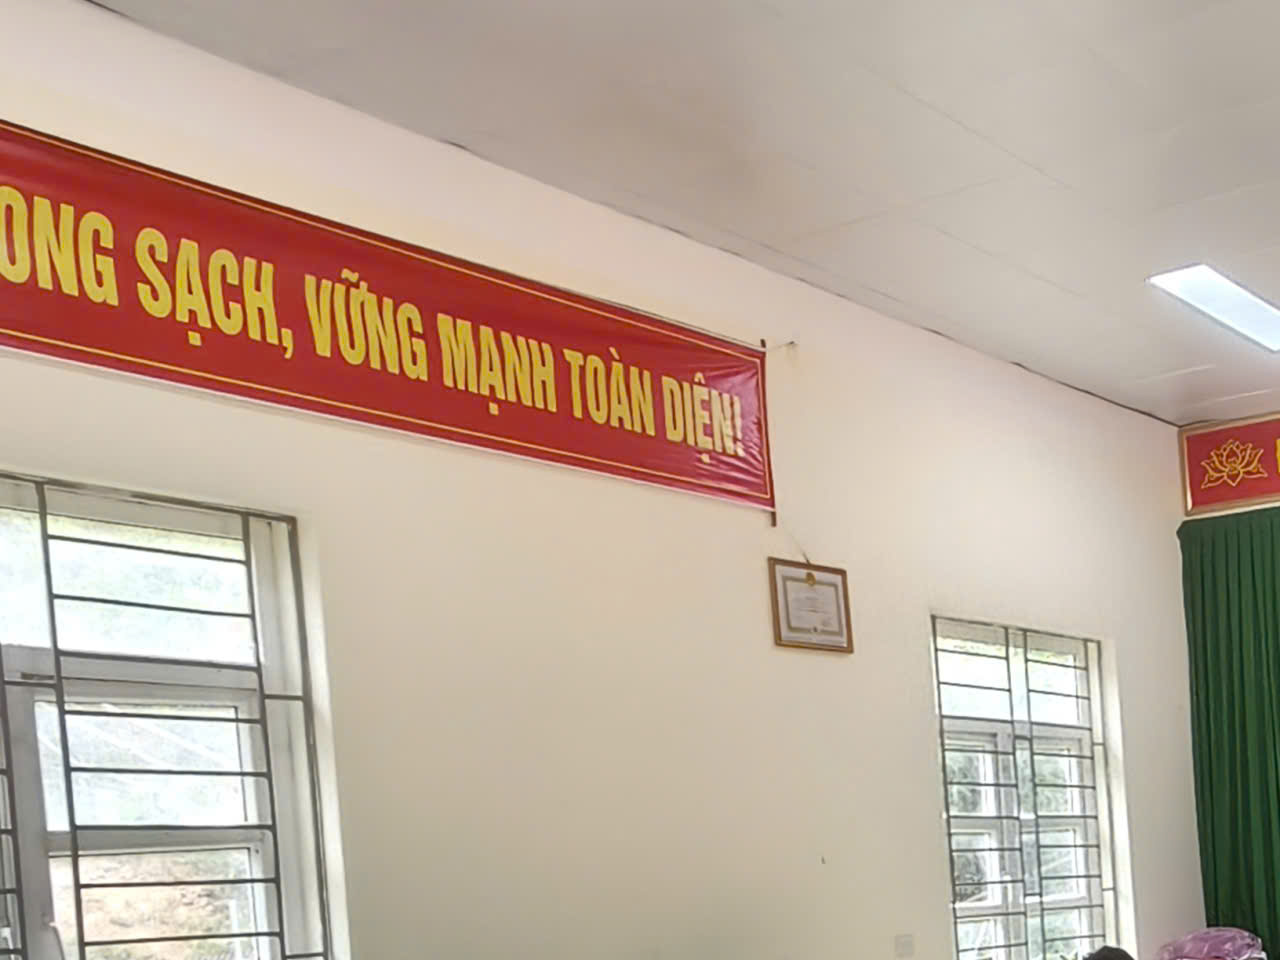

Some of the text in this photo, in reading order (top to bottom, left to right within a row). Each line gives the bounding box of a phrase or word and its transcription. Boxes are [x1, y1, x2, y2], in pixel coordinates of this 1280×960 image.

[135, 227, 293, 359] SẠCH,
[305, 268, 428, 382] VỮNG
[437, 312, 557, 416] MẠNH
[563, 346, 656, 437] TOÀN
[661, 371, 746, 464] DIỆN!
